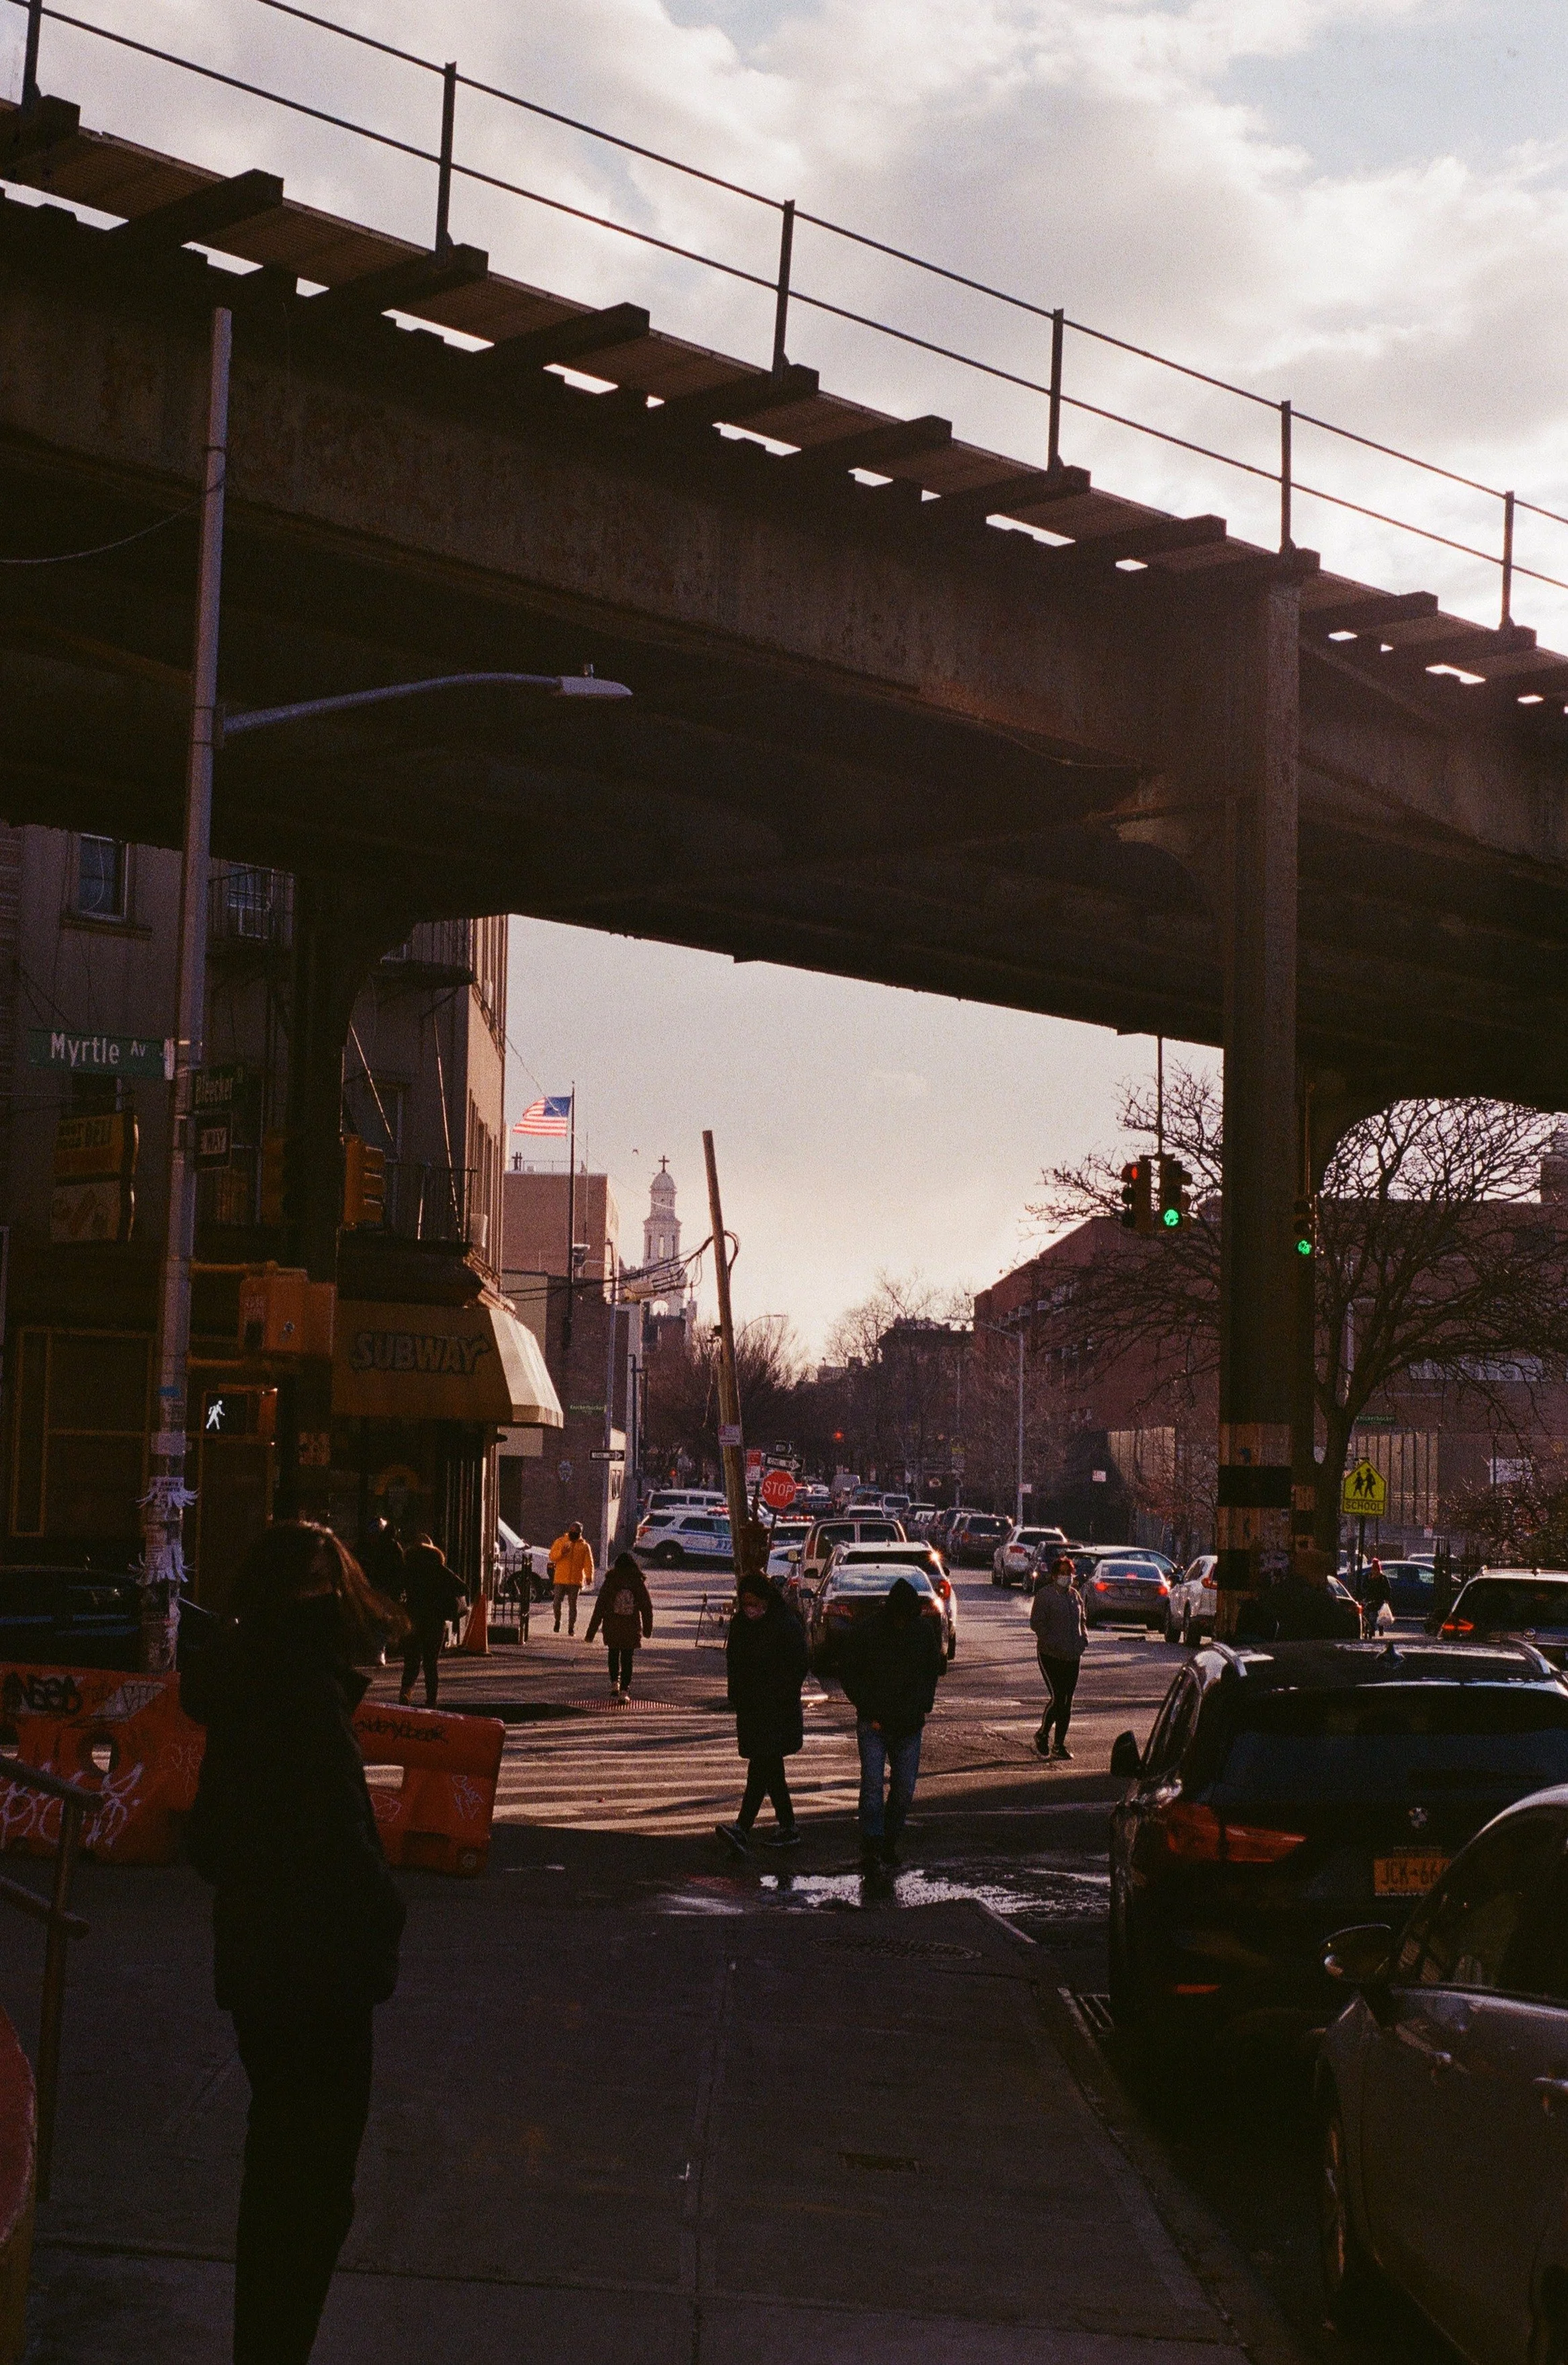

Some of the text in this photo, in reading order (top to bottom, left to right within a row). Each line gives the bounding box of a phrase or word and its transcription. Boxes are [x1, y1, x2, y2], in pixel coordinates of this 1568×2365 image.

[50, 1032, 147, 1067] Myrtle Av
[349, 1332, 493, 1375] SUBWAY
[764, 1481, 793, 1497] STOP
[1346, 1501, 1383, 1511] SCHOOL
